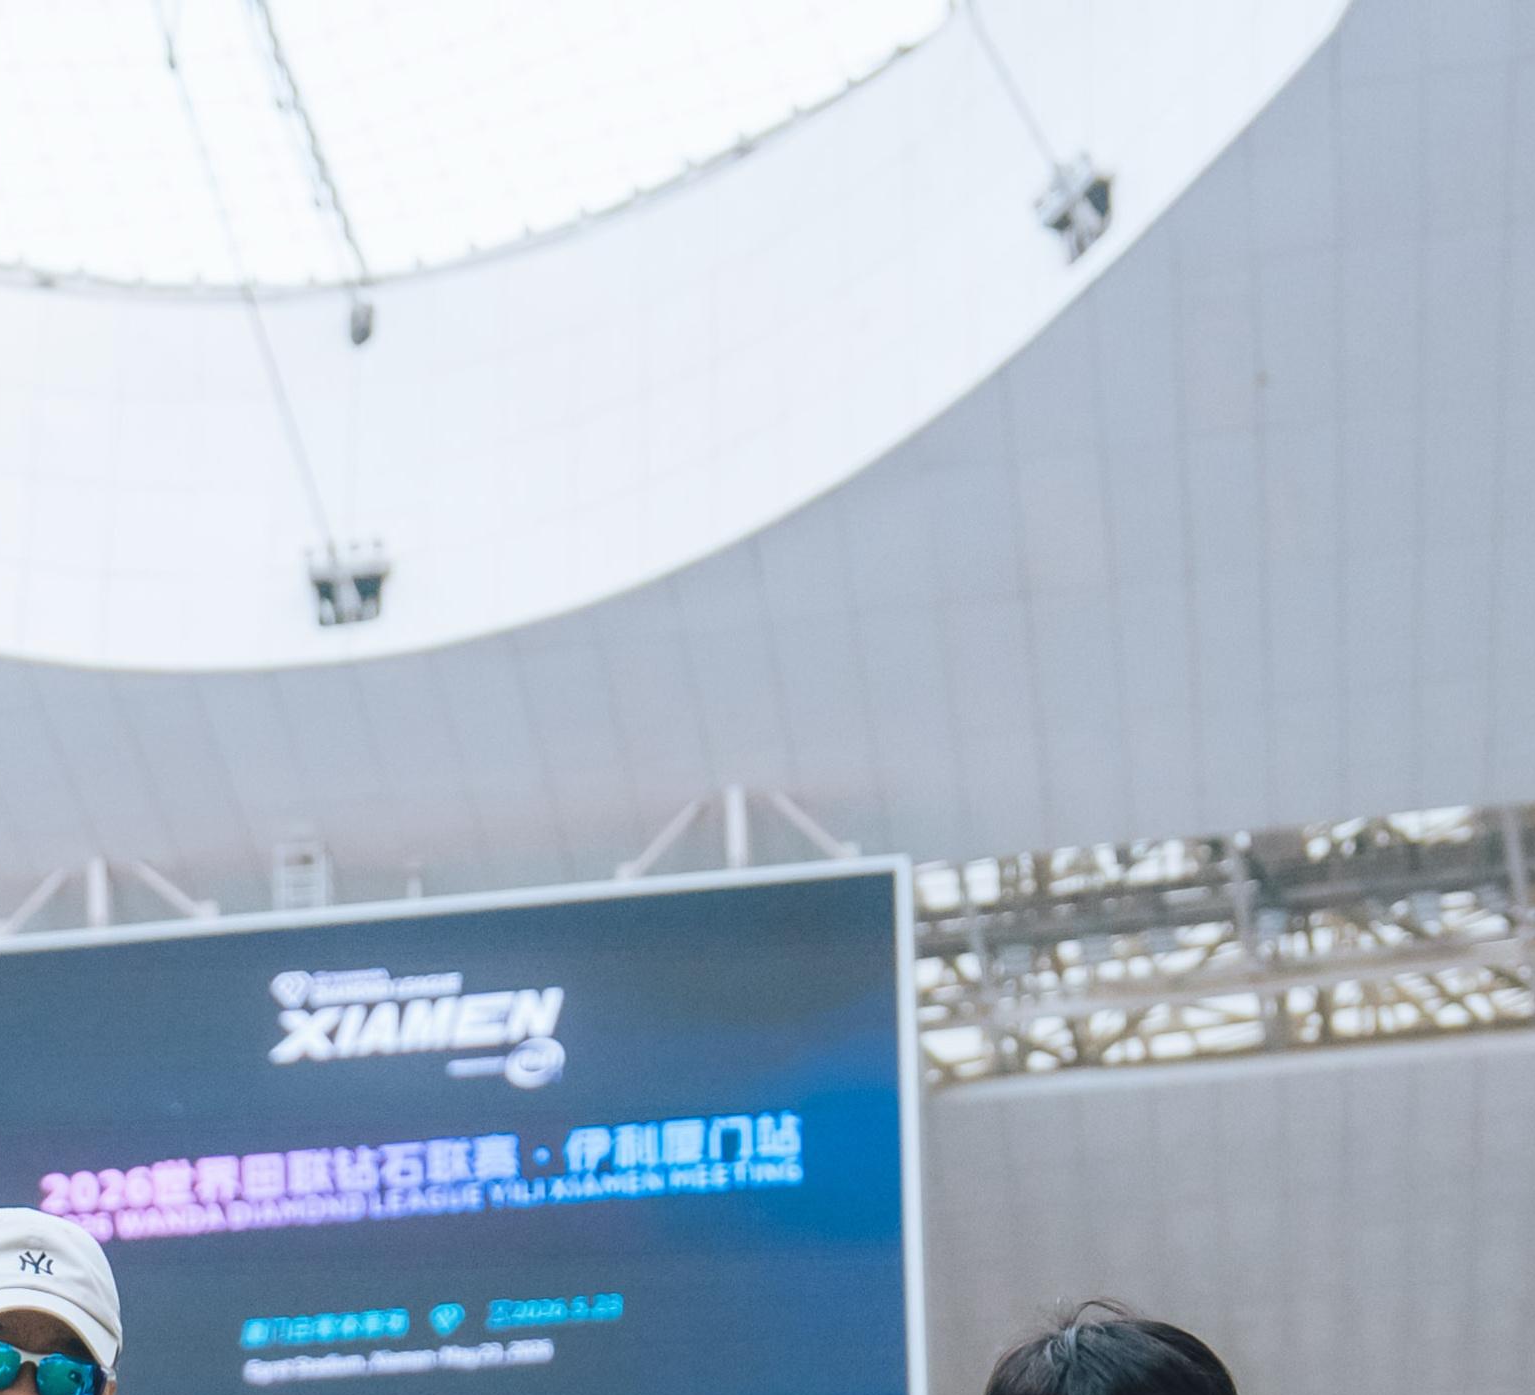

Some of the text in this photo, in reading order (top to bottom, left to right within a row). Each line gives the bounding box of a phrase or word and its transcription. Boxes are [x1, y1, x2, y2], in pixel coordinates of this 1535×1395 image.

[269, 987, 564, 1063] XIAMEN
[368, 1180, 484, 1219] LEAGUE
[668, 1160, 803, 1192] MEETING
[19, 1251, 54, 1275] NY
